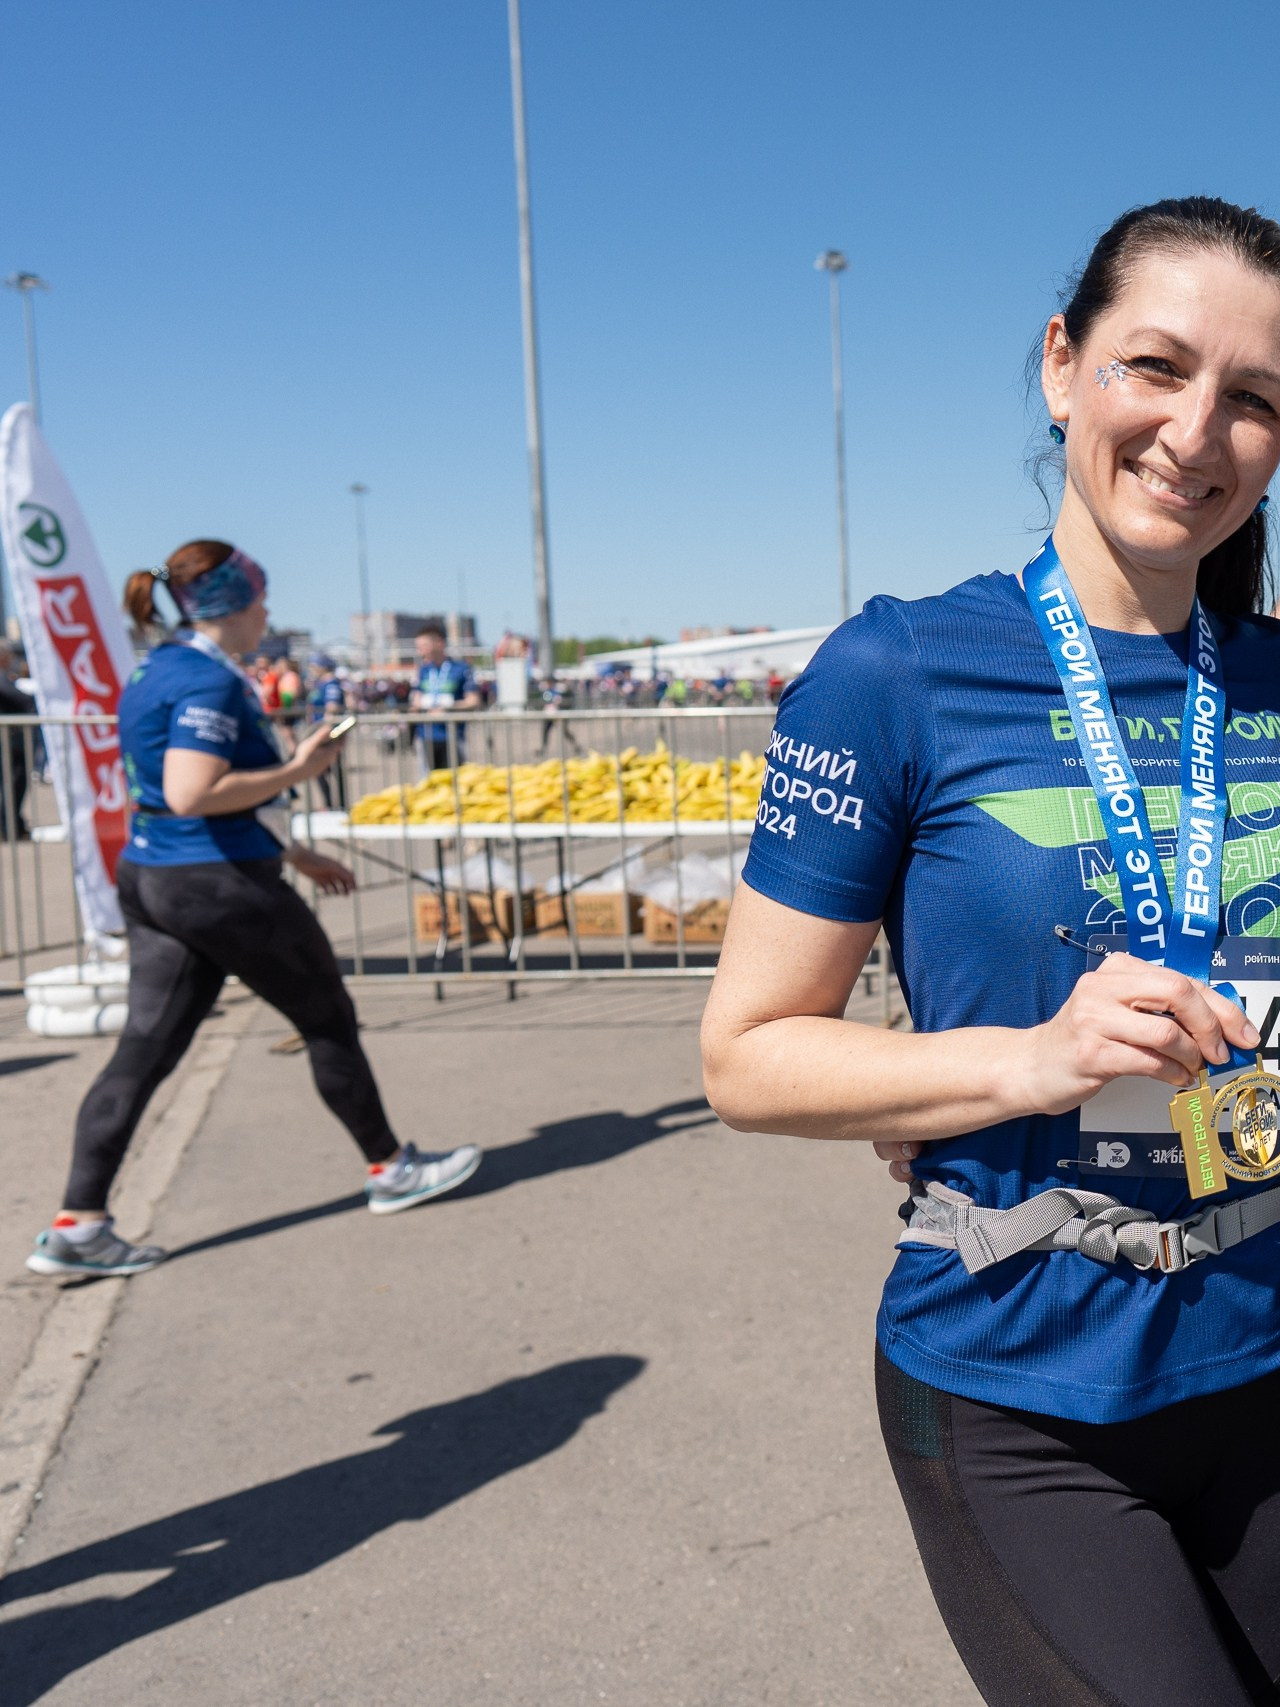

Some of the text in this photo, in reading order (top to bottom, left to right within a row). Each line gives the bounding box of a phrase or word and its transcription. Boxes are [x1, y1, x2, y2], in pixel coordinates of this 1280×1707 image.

[1039, 587, 1166, 949] ГЕРОИ МЕНЯЮТ ЭТОТ
[1191, 674, 1218, 812] МЕНЯЮТ
[757, 799, 797, 840] 024
[1181, 817, 1215, 938] ГЕРОИ
